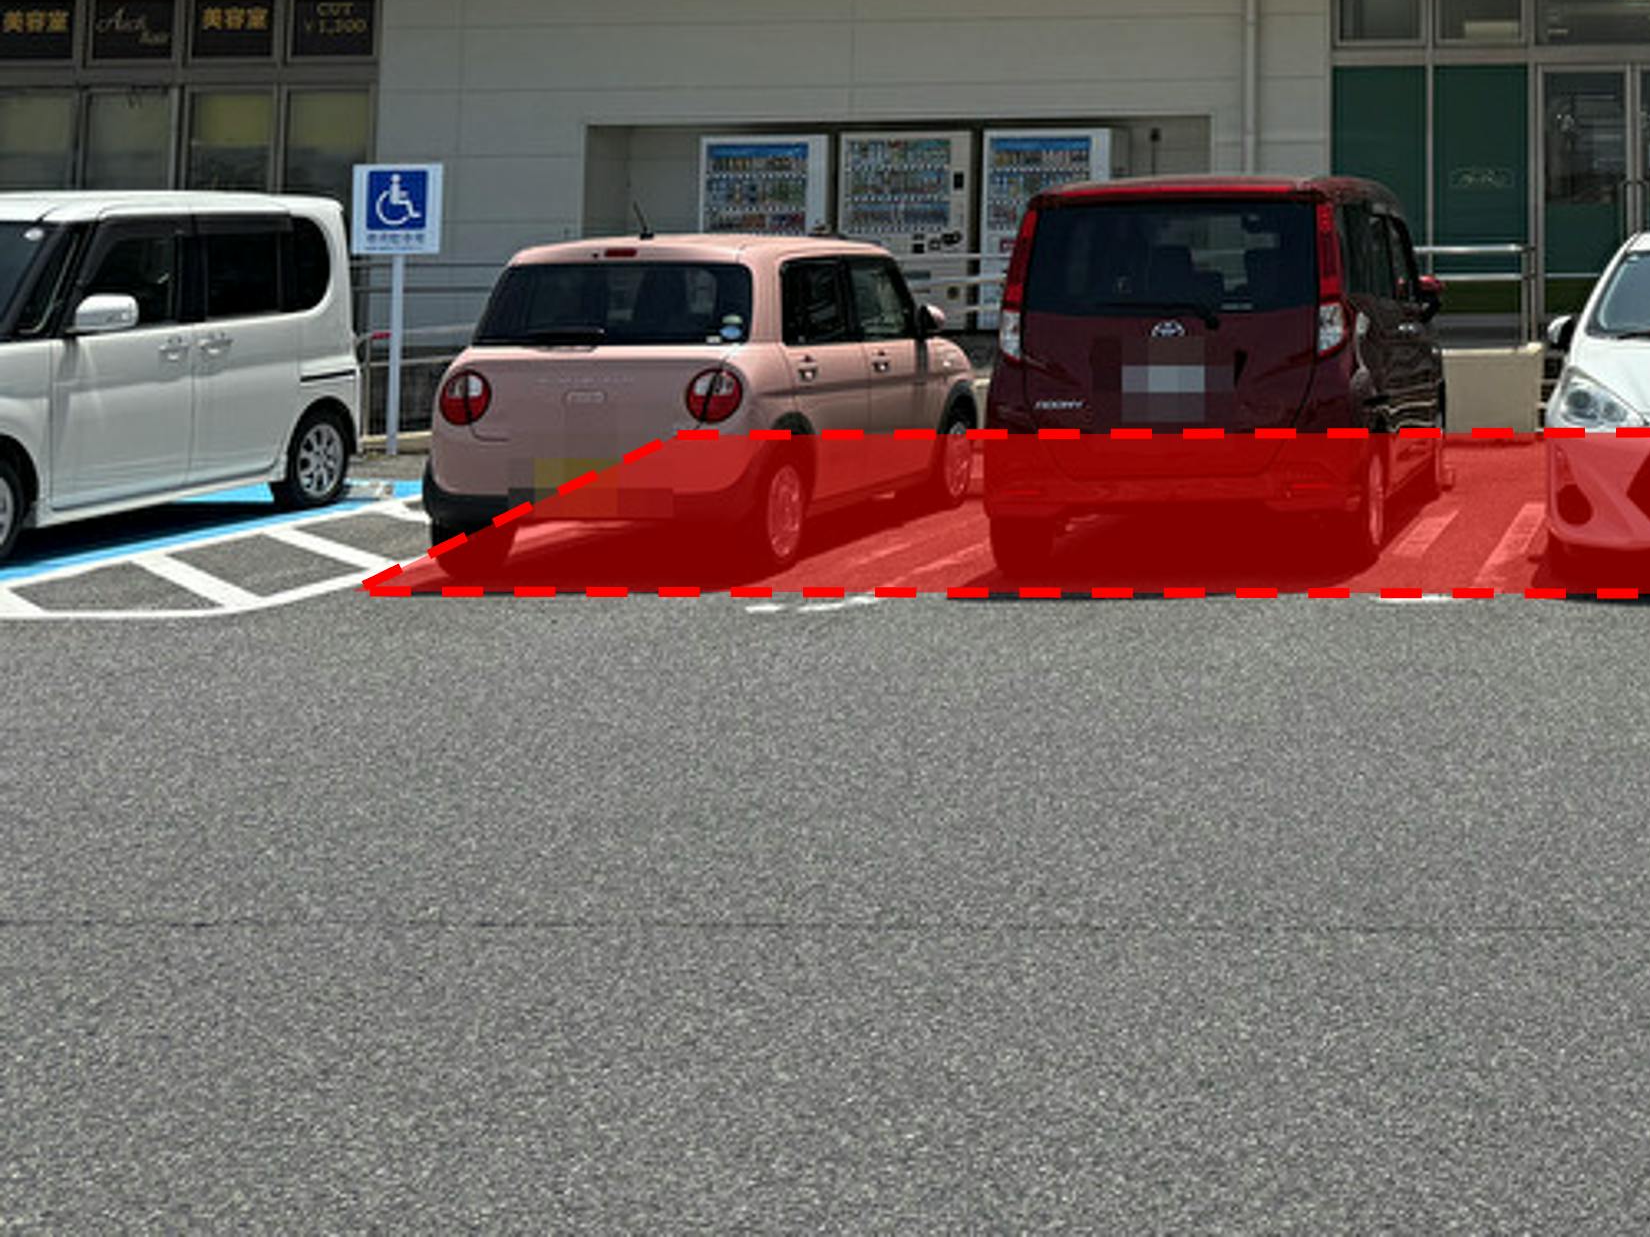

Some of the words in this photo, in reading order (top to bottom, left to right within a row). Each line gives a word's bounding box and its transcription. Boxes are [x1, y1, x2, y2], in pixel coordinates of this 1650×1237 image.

[3, 9, 70, 34] 美容室
[202, 6, 269, 31] 美容室
